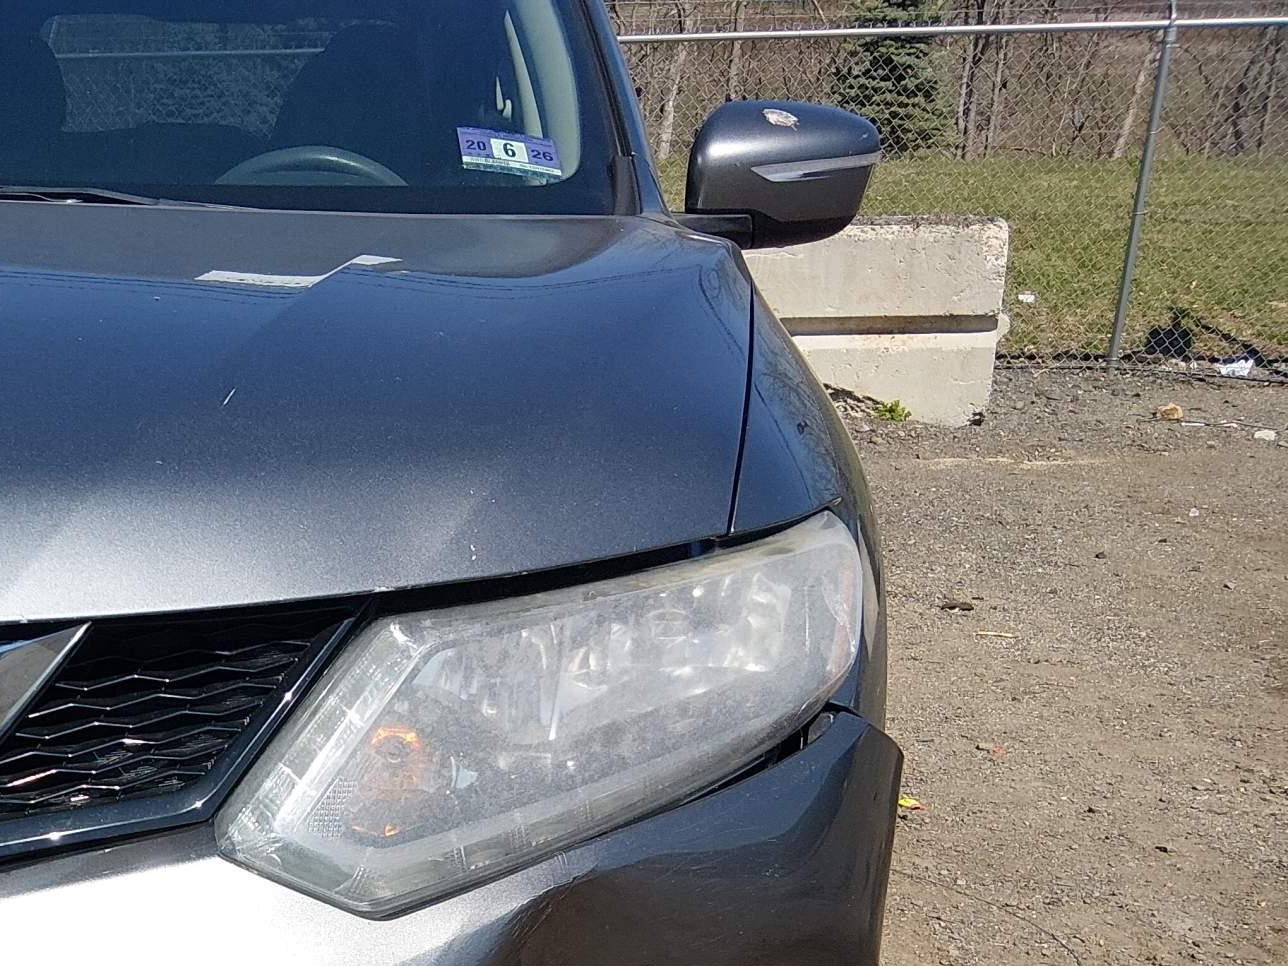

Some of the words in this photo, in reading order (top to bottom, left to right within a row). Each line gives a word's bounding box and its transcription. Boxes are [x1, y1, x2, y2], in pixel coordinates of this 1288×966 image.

[465, 139, 487, 151] 20
[502, 142, 517, 158] 6
[530, 149, 554, 162] 26
